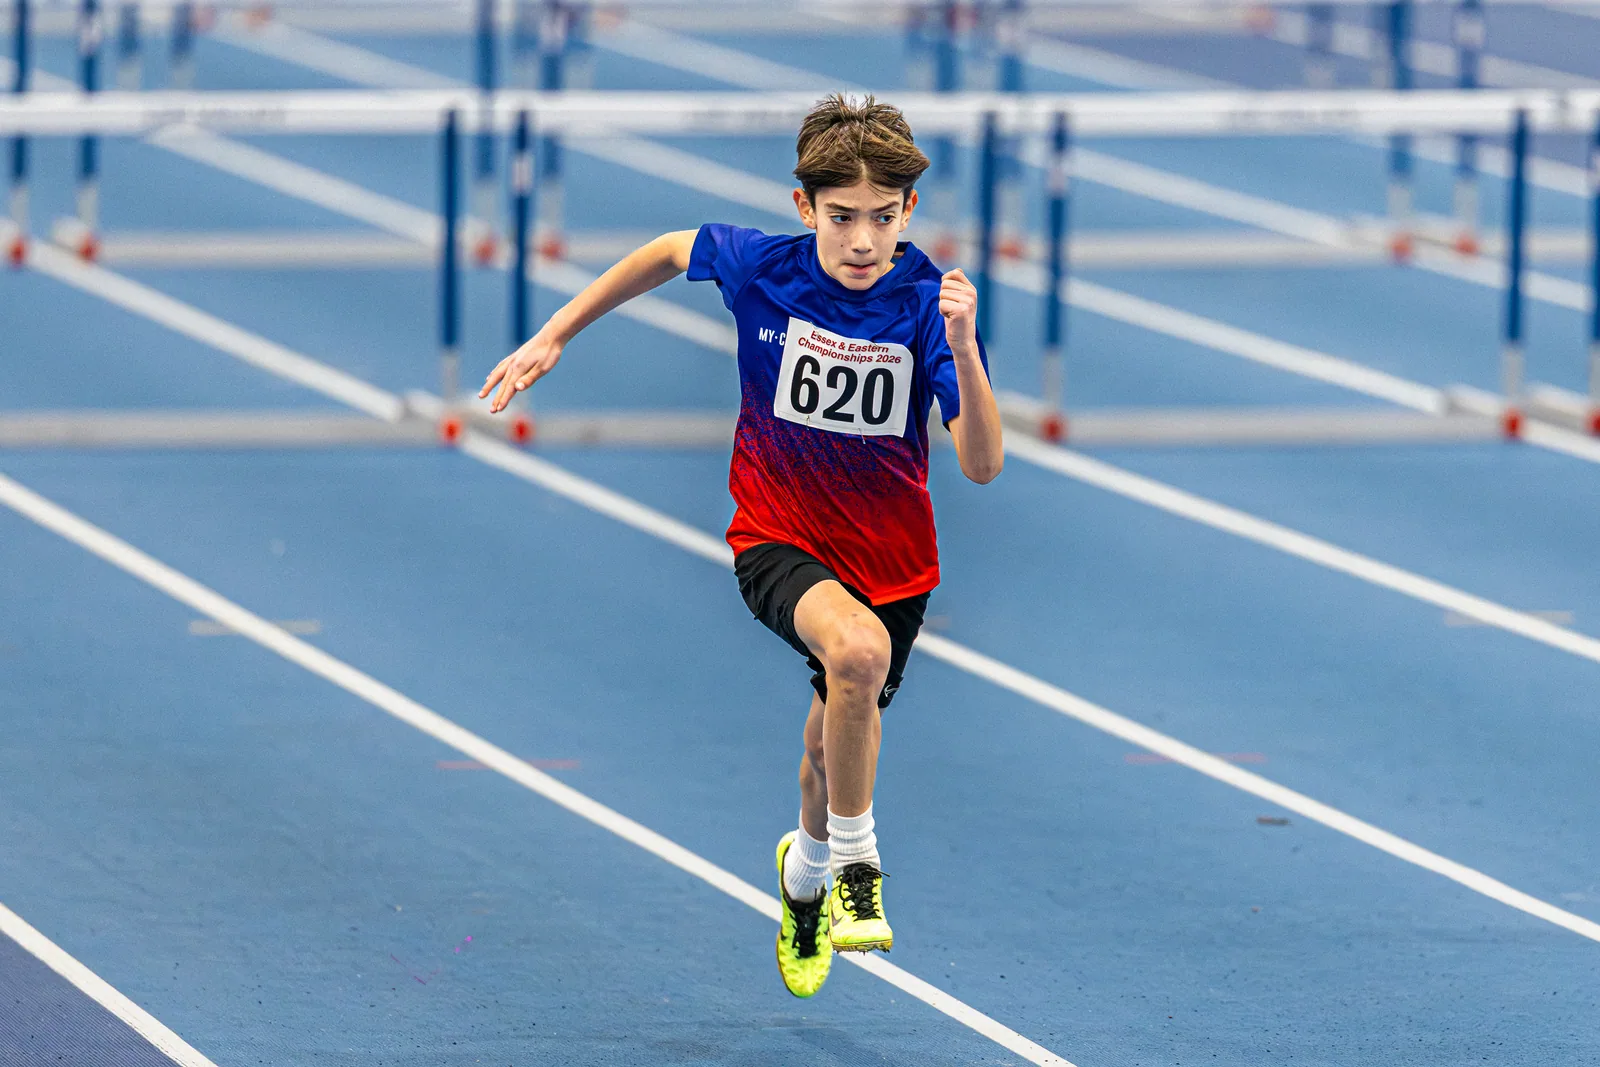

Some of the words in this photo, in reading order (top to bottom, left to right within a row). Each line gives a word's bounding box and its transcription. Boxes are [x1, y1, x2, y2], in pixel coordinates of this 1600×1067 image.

[798, 337, 873, 364] Championships
[876, 354, 902, 364] 2026
[810, 330, 838, 348] Essex
[838, 341, 848, 351] &
[847, 343, 889, 353] Eastern
[790, 354, 895, 426] 620
